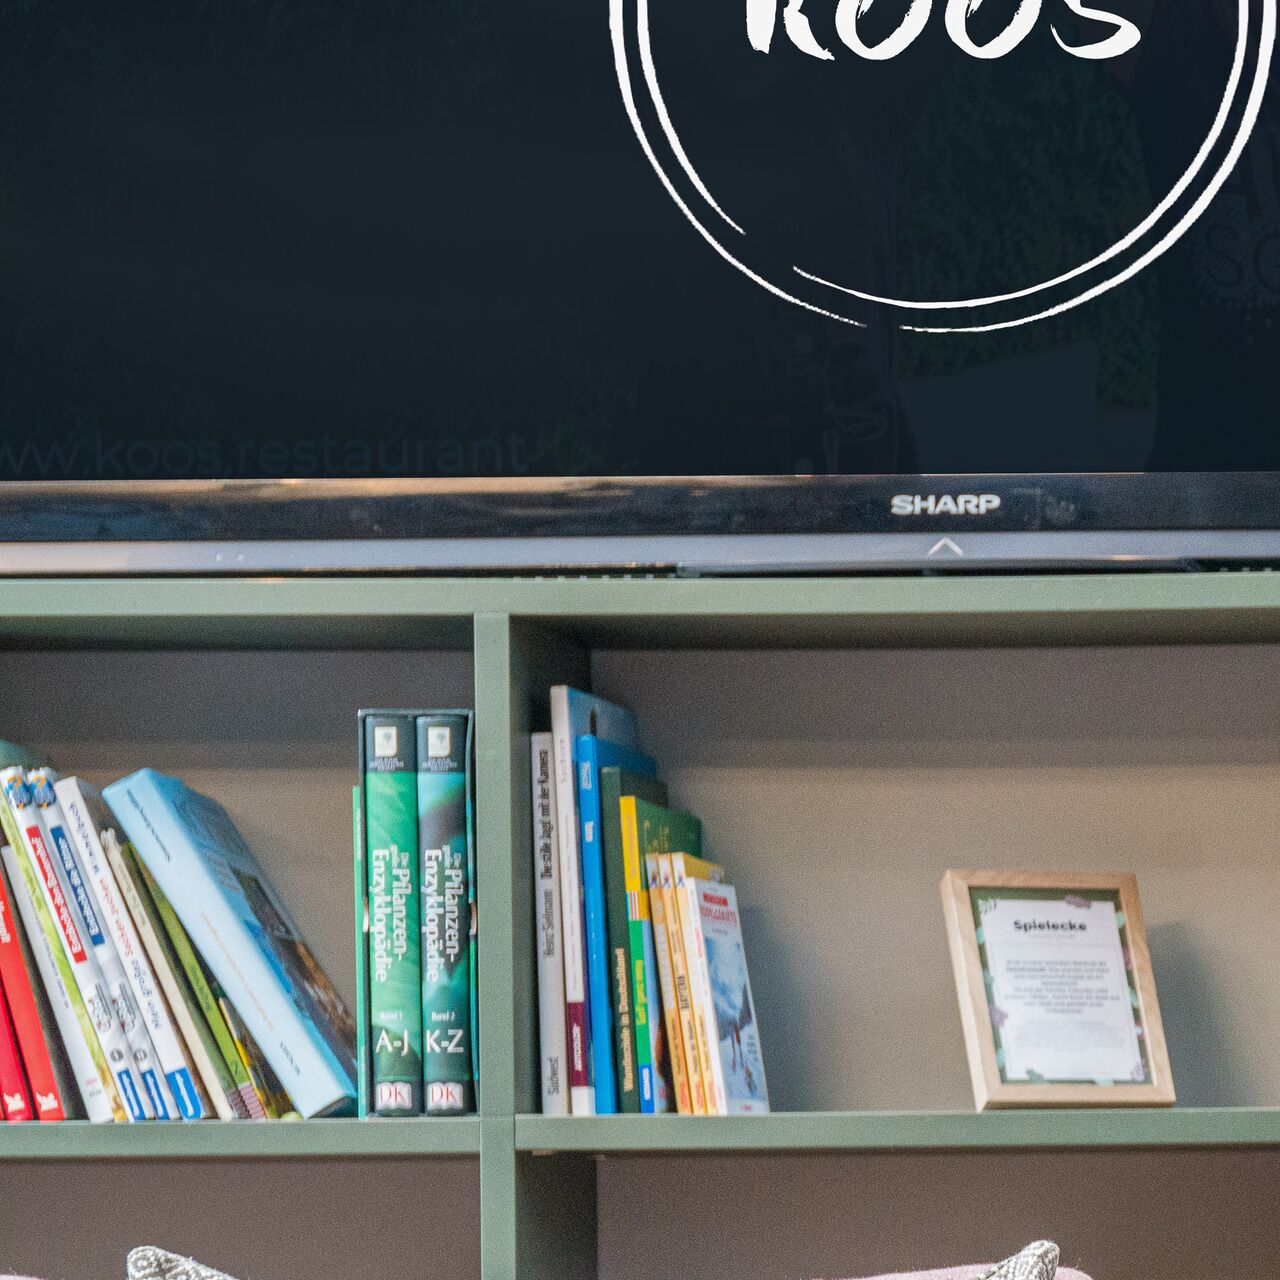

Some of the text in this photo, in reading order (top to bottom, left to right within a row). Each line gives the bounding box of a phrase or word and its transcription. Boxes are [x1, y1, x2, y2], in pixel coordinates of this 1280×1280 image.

[891, 494, 1000, 515] SHARP
[369, 849, 394, 983] Enzyklopädie
[421, 849, 442, 983] Enzyklopädie
[1013, 919, 1087, 933] Spielecke
[375, 1029, 409, 1055] A-J
[426, 1029, 464, 1054] K-Z
[379, 1085, 408, 1107] DK
[430, 1085, 459, 1107] DK
